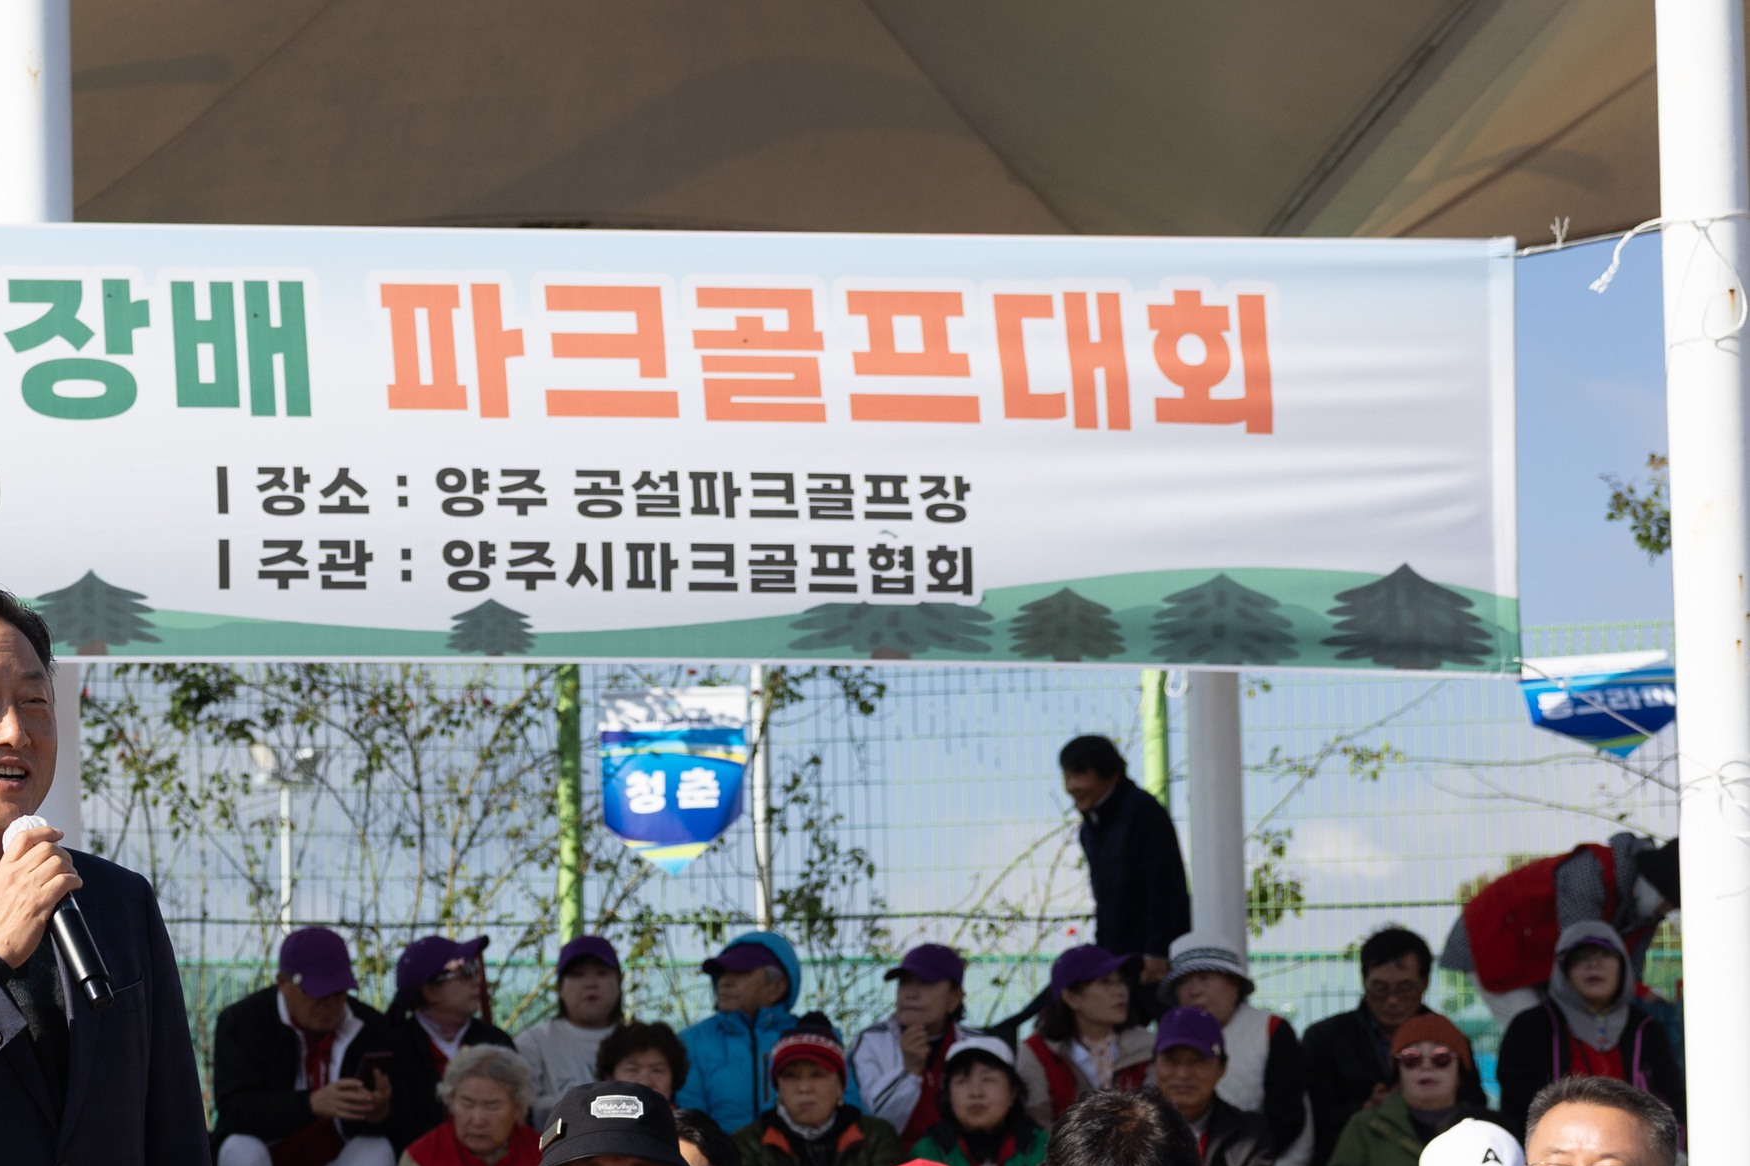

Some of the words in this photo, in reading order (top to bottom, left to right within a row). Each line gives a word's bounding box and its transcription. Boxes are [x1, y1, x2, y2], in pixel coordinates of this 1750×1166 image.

[380, 282, 1274, 435] 파크골프대회
[256, 466, 371, 516] 장소
[435, 467, 549, 518] 양주
[573, 469, 972, 524] 공설파크골프장
[256, 539, 374, 591] 주관
[442, 539, 974, 596] 양주시파크골프협회
